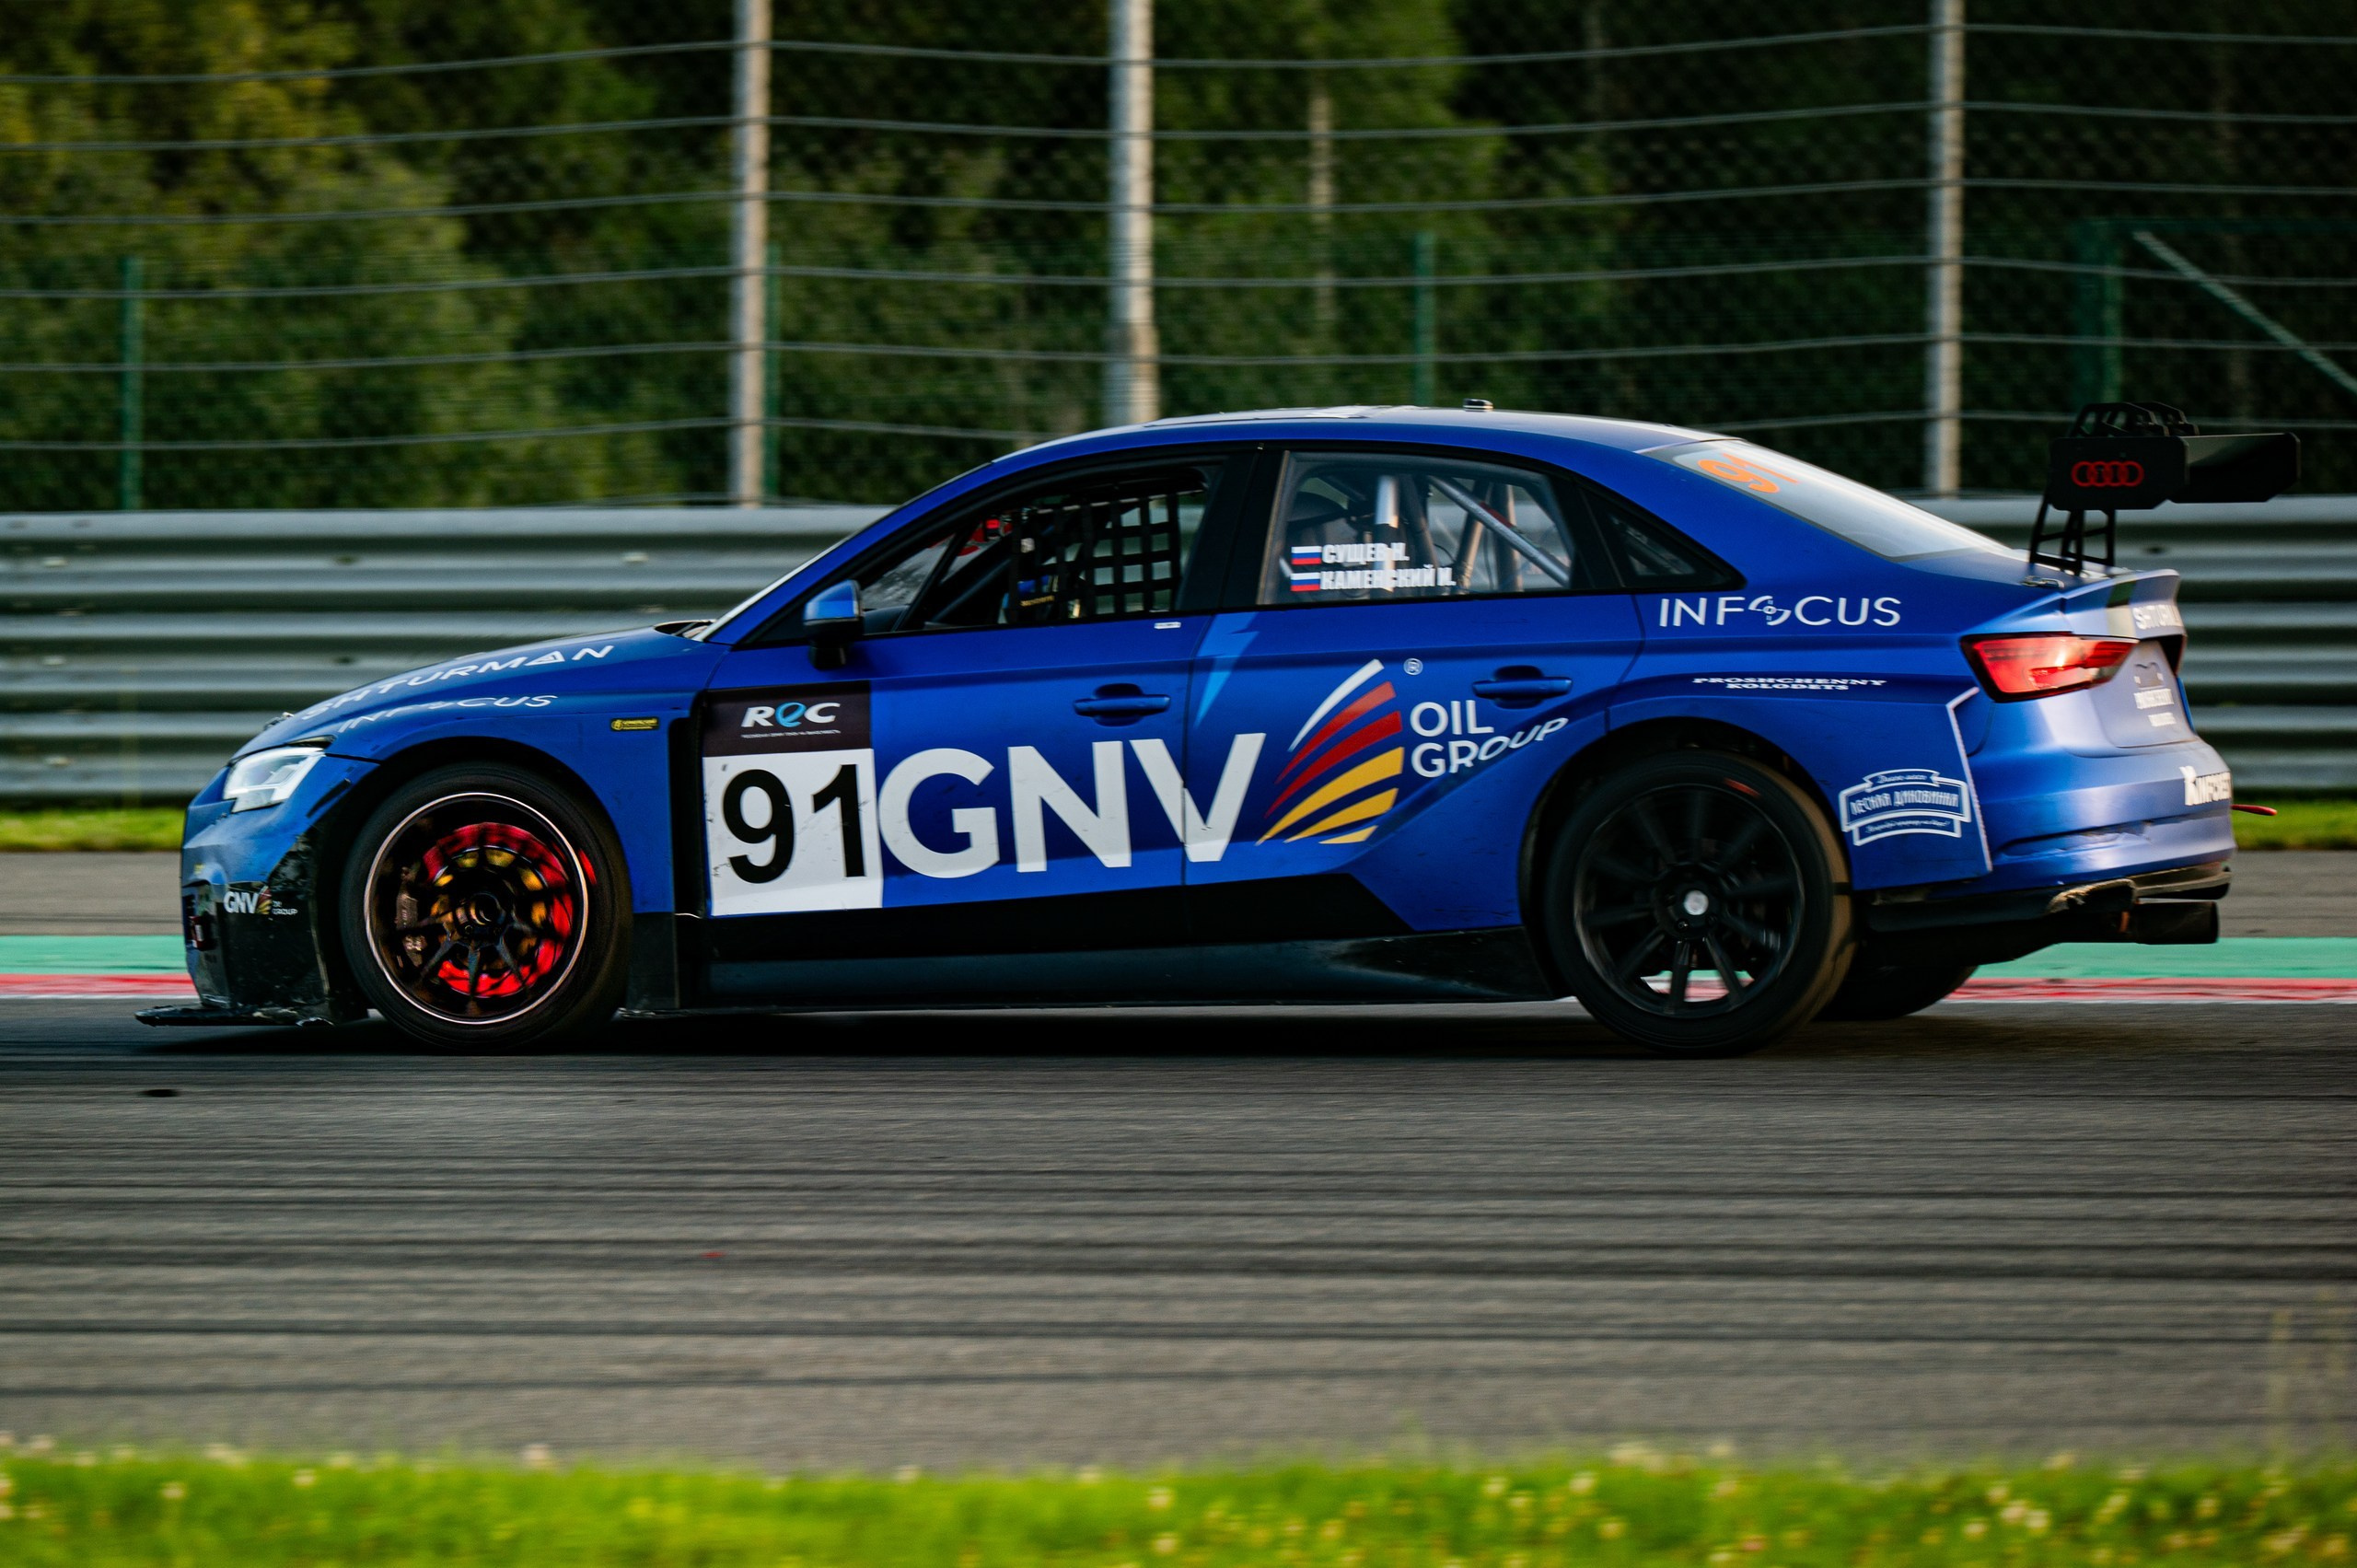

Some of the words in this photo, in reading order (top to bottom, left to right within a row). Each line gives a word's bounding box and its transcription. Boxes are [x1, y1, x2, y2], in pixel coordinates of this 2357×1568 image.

[1698, 452, 1801, 494] 91
[301, 645, 614, 721] SHTURMAN
[1692, 677, 1887, 686] PROSHCHENNY
[1725, 682, 1850, 691] KOLODETS
[1410, 700, 1494, 737] OIL
[1411, 717, 1569, 778] GROUP
[722, 763, 866, 884] 91
[879, 733, 1266, 878] GNV
[223, 890, 259, 914] GNV
